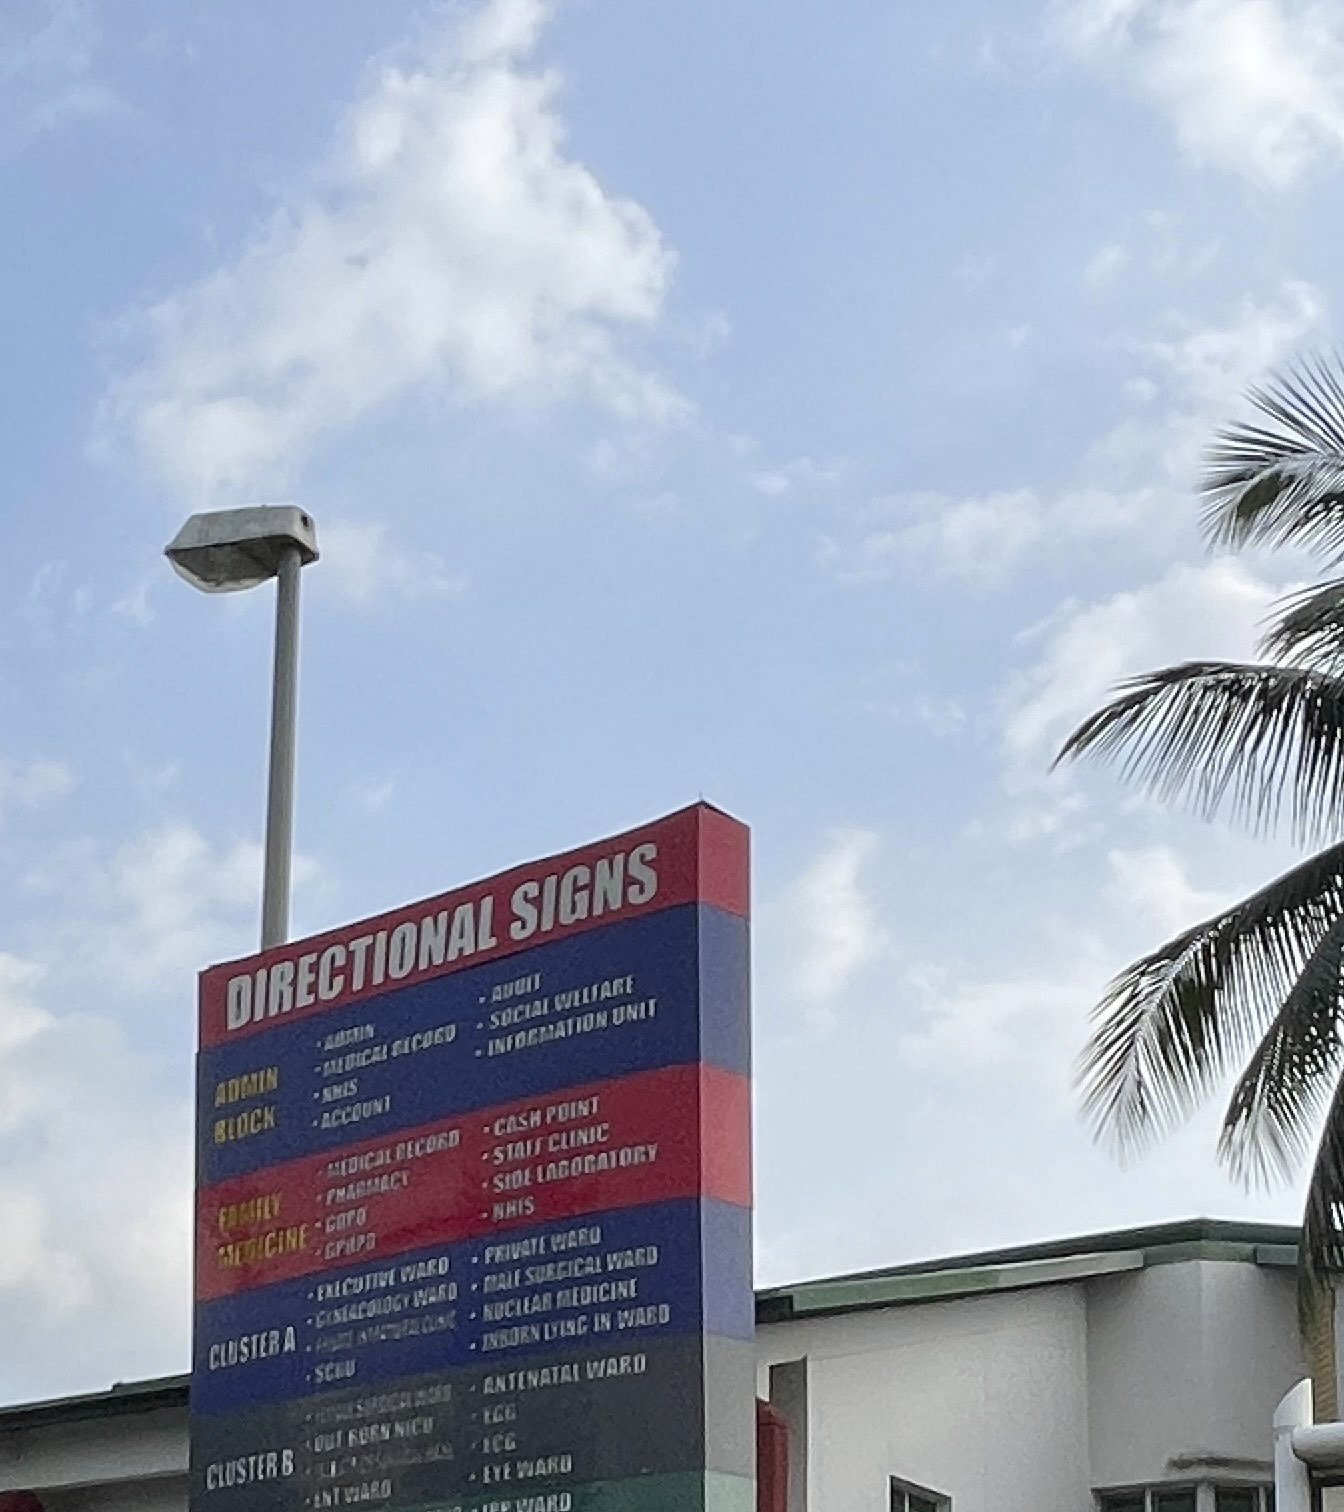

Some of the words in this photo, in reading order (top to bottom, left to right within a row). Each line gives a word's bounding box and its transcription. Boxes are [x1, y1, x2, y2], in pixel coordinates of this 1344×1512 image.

[226, 895, 497, 1031] DIRECTIONAL
[510, 843, 657, 941] SIGNS
[488, 1011, 607, 1057] INFORMATION
[612, 998, 657, 1026] UNIT
[489, 998, 549, 1030] SOCIAL
[215, 1067, 278, 1108] ADMIN
[214, 1106, 276, 1144] BLOCK
[321, 1095, 390, 1129] ACCOUNT
[494, 1109, 541, 1135] CASH
[546, 1095, 599, 1124] POINT
[548, 1123, 609, 1150] CLINIC
[484, 1238, 545, 1264] PRIVATE
[551, 1226, 602, 1252] WARD
[400, 1256, 449, 1283] WARD
[524, 1256, 602, 1285] SURGICAL
[607, 1246, 658, 1271] WARD
[557, 1277, 638, 1308] MEDICINE
[594, 1312, 611, 1332] IN
[617, 1304, 670, 1329] WARD
[209, 1330, 279, 1371] CLUSTER
[283, 1327, 296, 1352] A
[484, 1363, 579, 1394] ANTENATAL
[586, 1353, 646, 1380] WARD
[207, 1453, 277, 1491] CLUSTER
[282, 1449, 294, 1476] B
[483, 1462, 511, 1483] EYE
[517, 1455, 572, 1479] WARD
